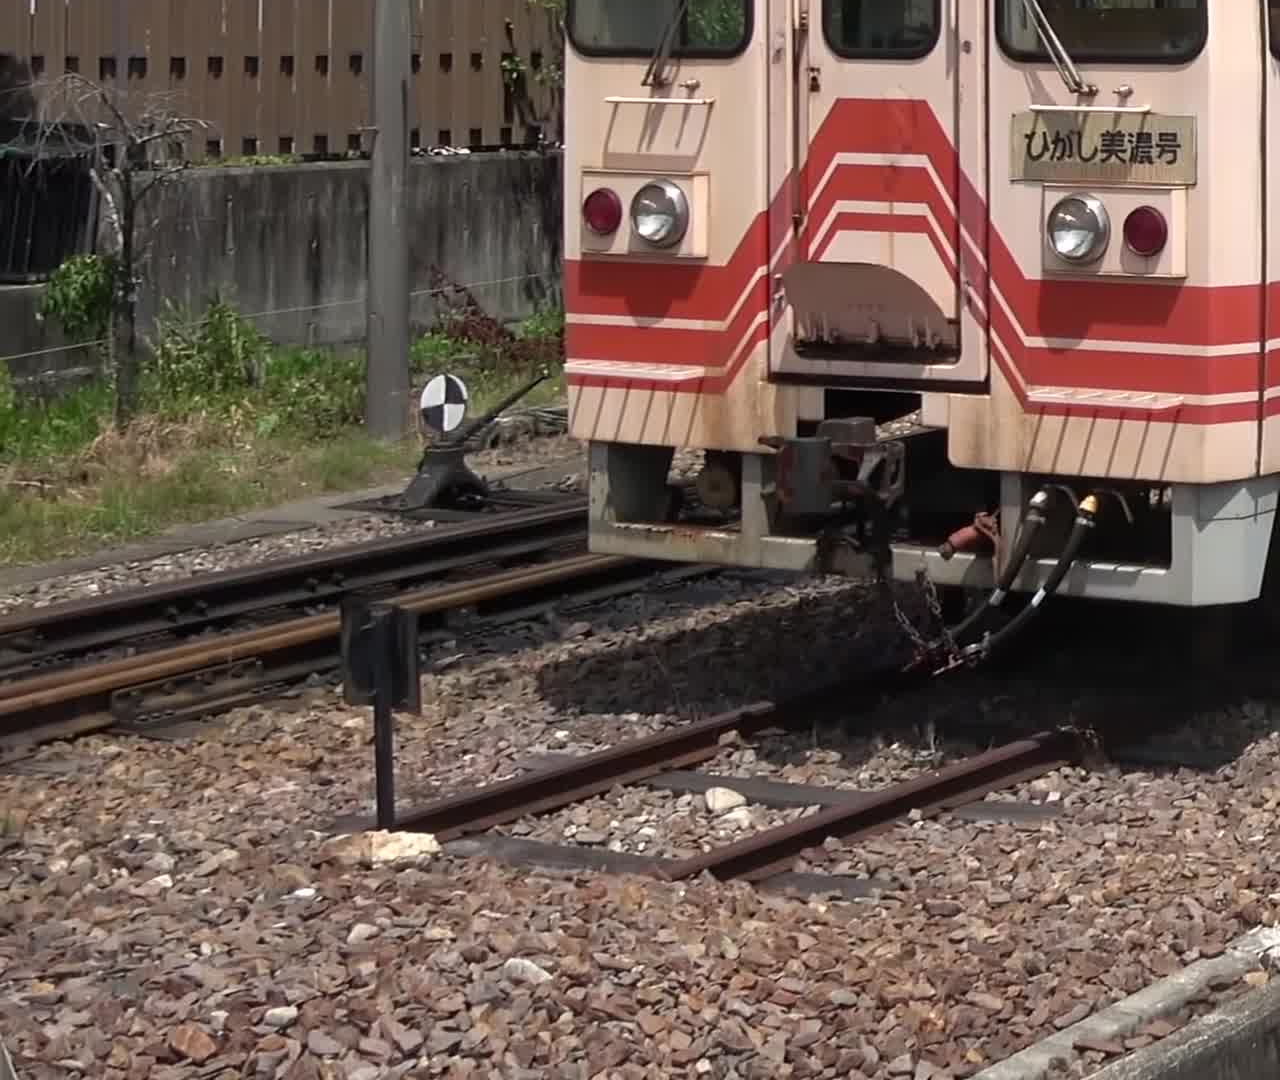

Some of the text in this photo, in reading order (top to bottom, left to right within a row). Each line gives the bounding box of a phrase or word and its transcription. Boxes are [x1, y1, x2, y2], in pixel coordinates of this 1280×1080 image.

[1024, 130, 1181, 164] ひがし美濃号
